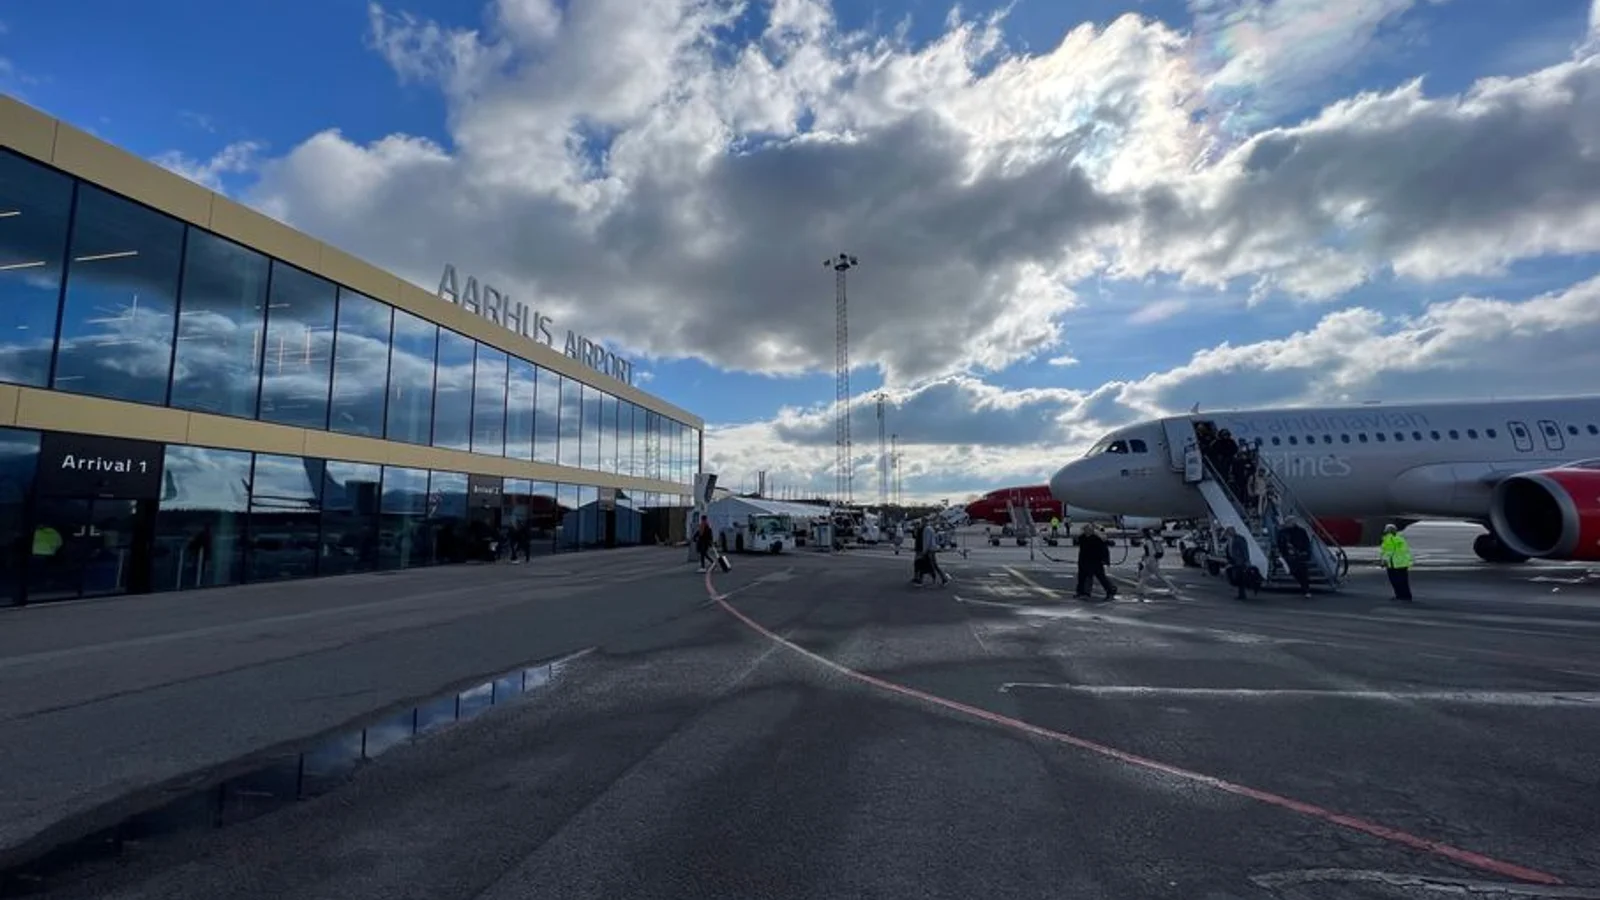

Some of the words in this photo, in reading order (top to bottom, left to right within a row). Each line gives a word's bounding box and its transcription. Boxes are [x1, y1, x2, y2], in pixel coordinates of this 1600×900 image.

[438, 263, 553, 346] AARHUS
[564, 330, 633, 385] AIRPORT
[1232, 410, 1430, 434] Scandinavian
[61, 455, 131, 473] Arrival
[139, 460, 147, 473] 1
